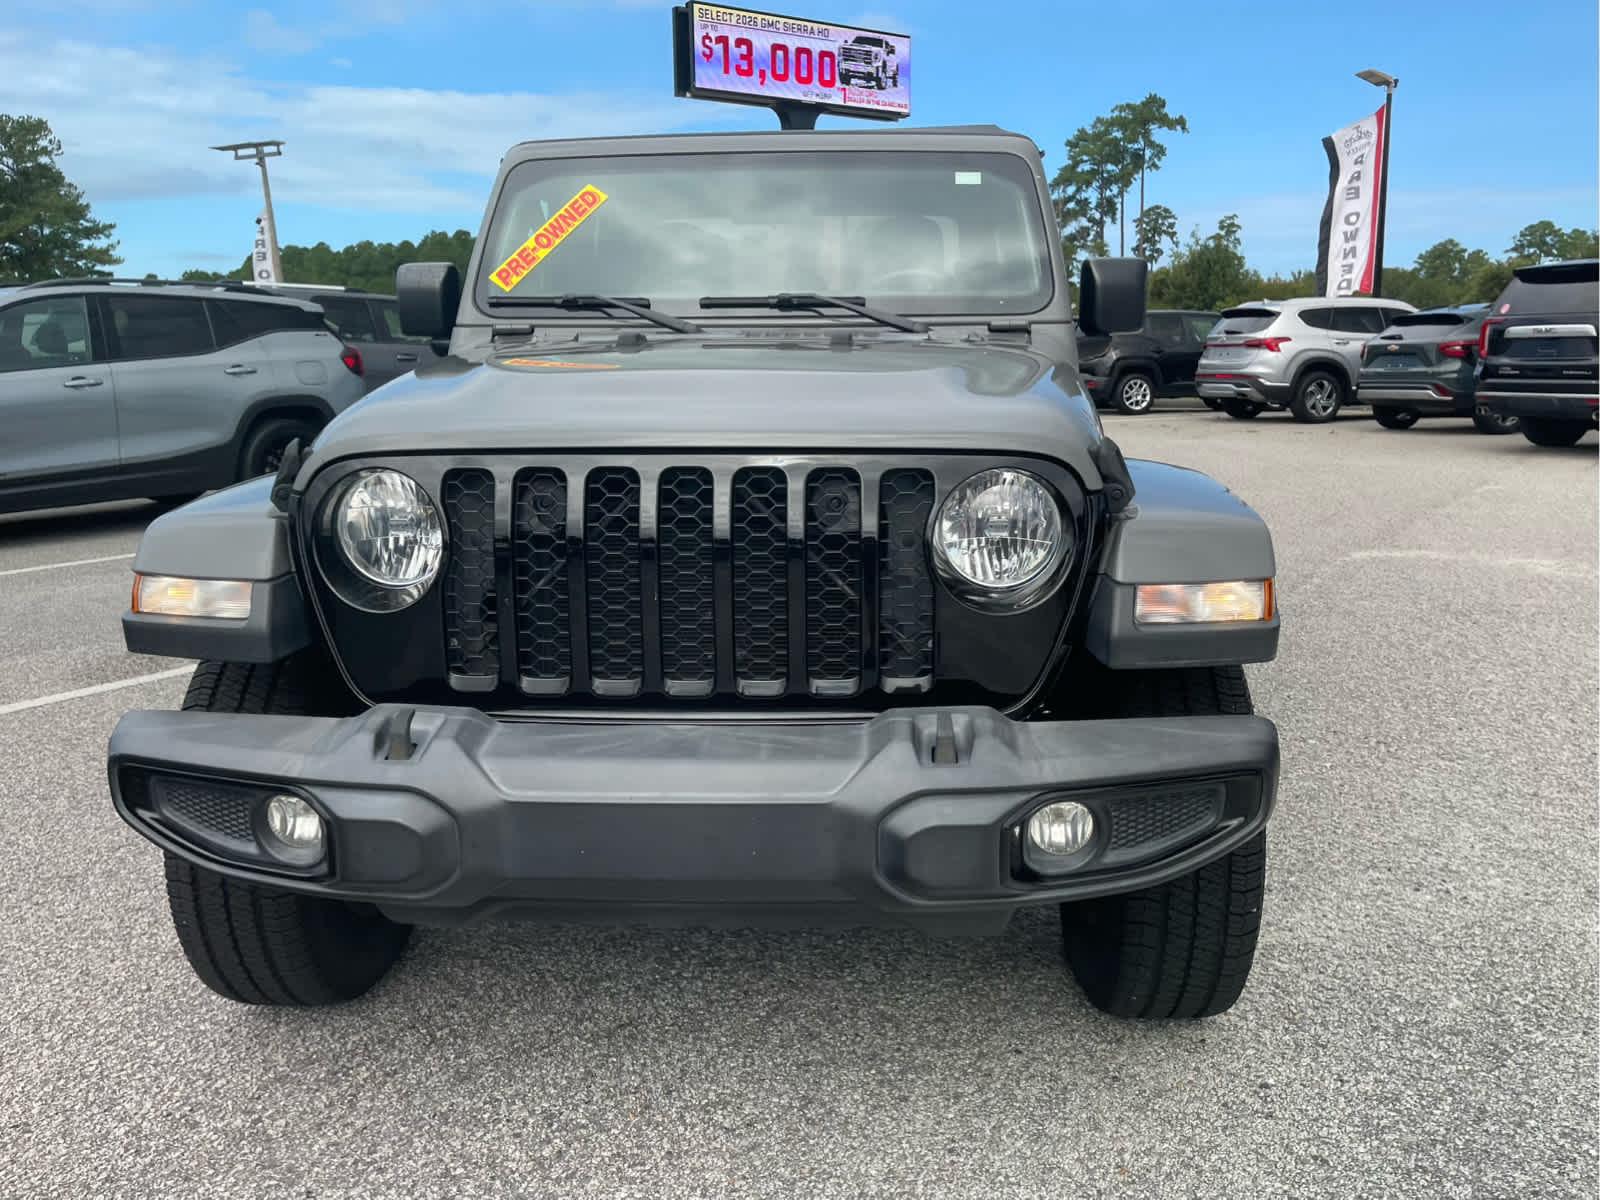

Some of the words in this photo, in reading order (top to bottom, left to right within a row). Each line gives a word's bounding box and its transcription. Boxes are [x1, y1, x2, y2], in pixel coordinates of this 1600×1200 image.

[698, 7, 734, 23] SELECT
[735, 13, 758, 27] 2026
[760, 17, 781, 31] GMC
[783, 21, 816, 36] SIERRA
[700, 23, 710, 31] UP
[710, 24, 719, 32] TO
[701, 32, 837, 89] $13,000
[495, 190, 600, 288] PRE-OWNED
